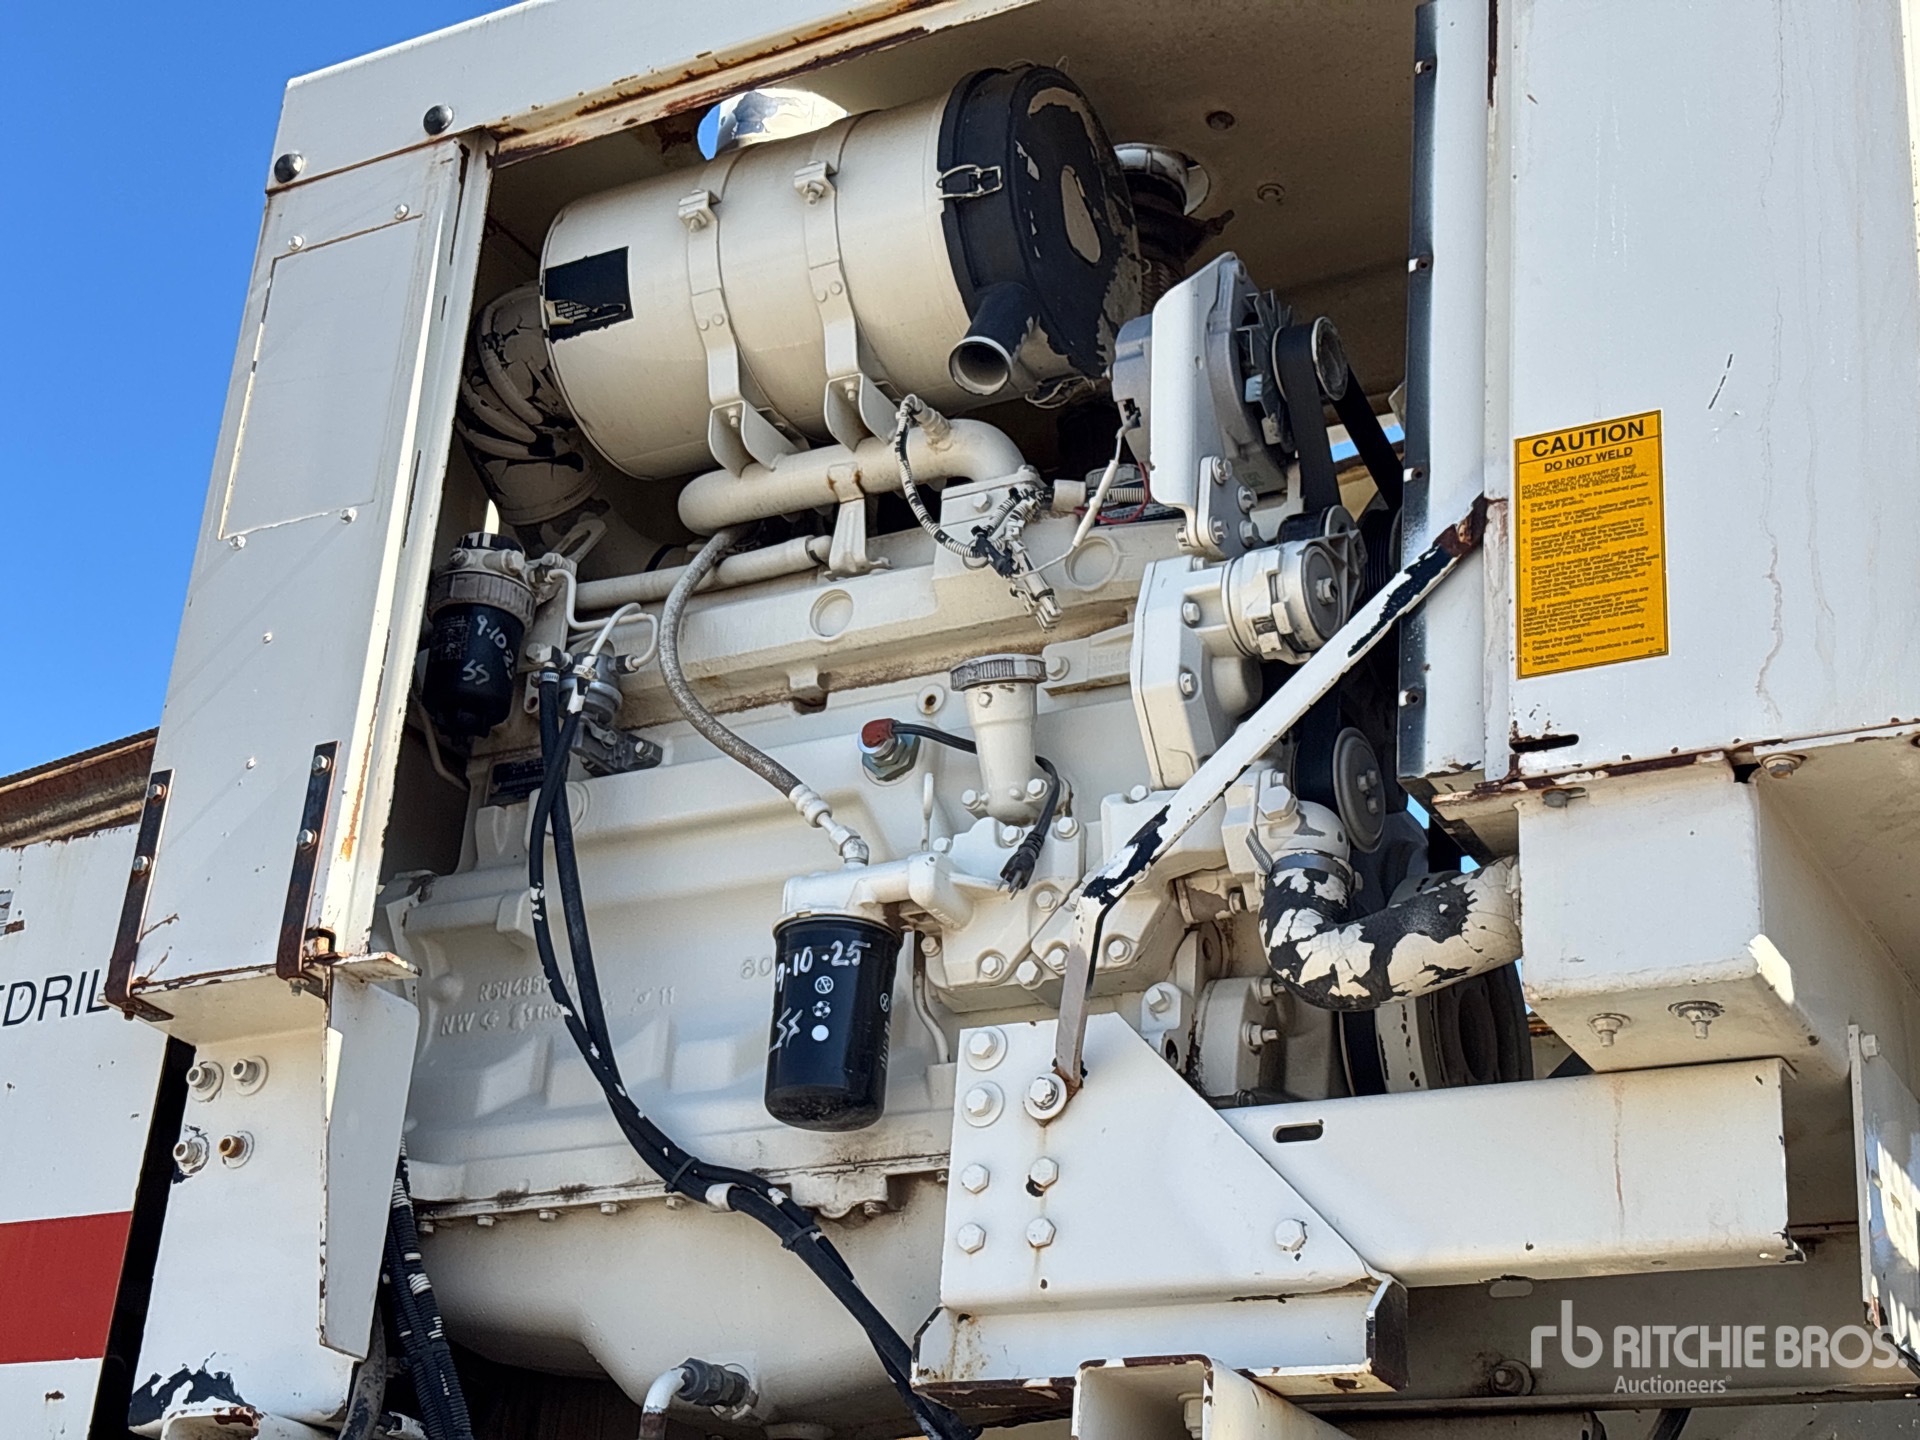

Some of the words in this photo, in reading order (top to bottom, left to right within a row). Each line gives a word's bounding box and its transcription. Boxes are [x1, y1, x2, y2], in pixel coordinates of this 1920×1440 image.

[1532, 419, 1644, 458] CAUTION
[1544, 460, 1562, 472] DO
[1566, 454, 1592, 468] NOT
[1596, 446, 1632, 462] WELD
